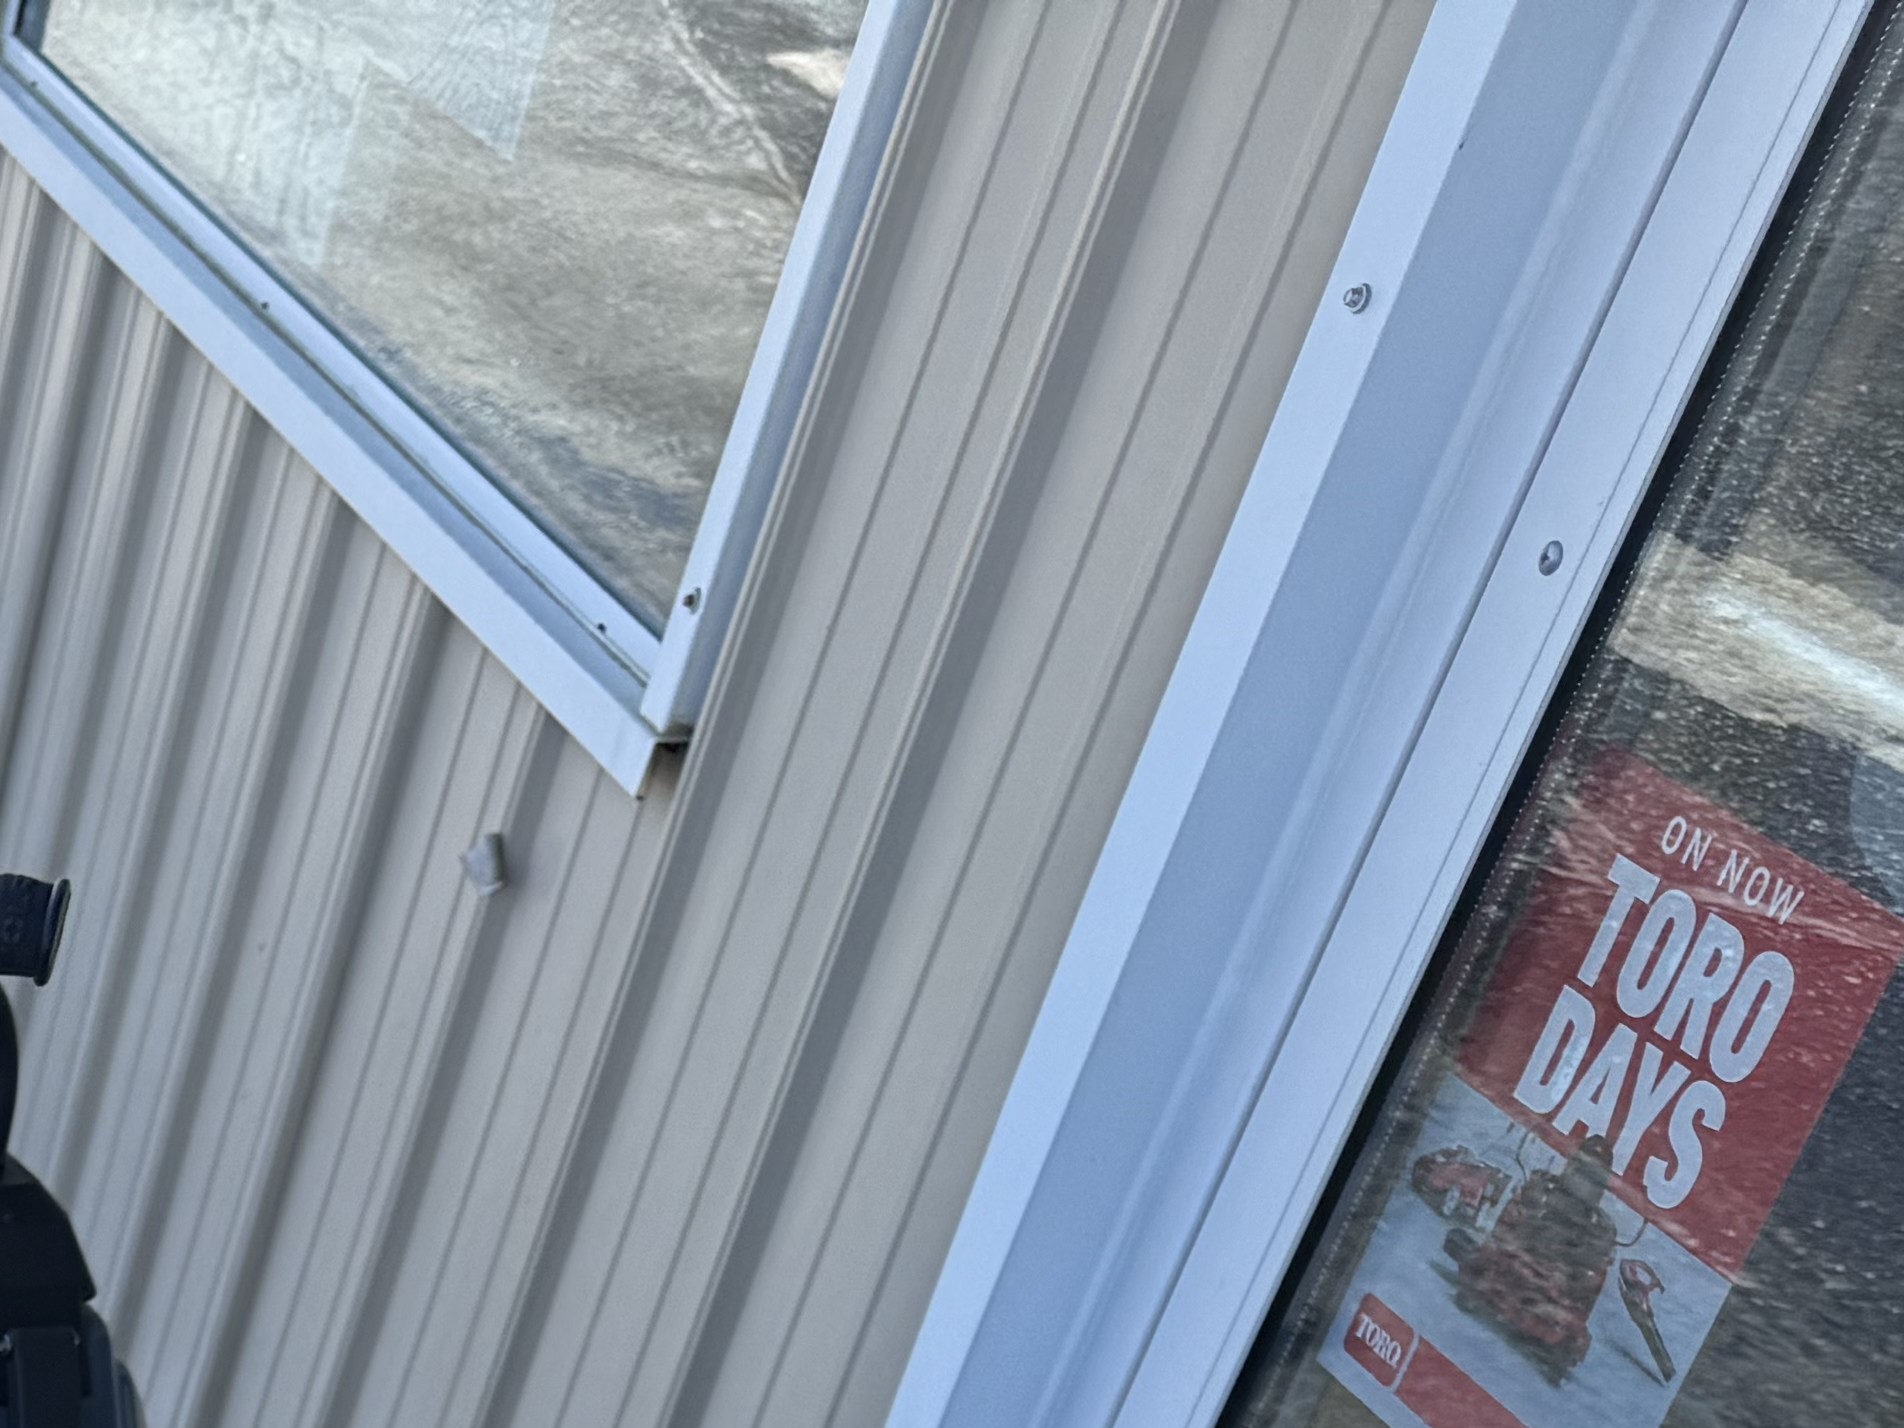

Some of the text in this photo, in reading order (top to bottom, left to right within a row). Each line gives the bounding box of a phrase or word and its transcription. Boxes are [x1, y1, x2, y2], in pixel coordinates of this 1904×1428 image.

[1662, 816, 1804, 925] ON NOW
[1577, 853, 1795, 1083] TORO
[1513, 984, 1727, 1209] DAYS
[1353, 1311, 1404, 1368] TORO
